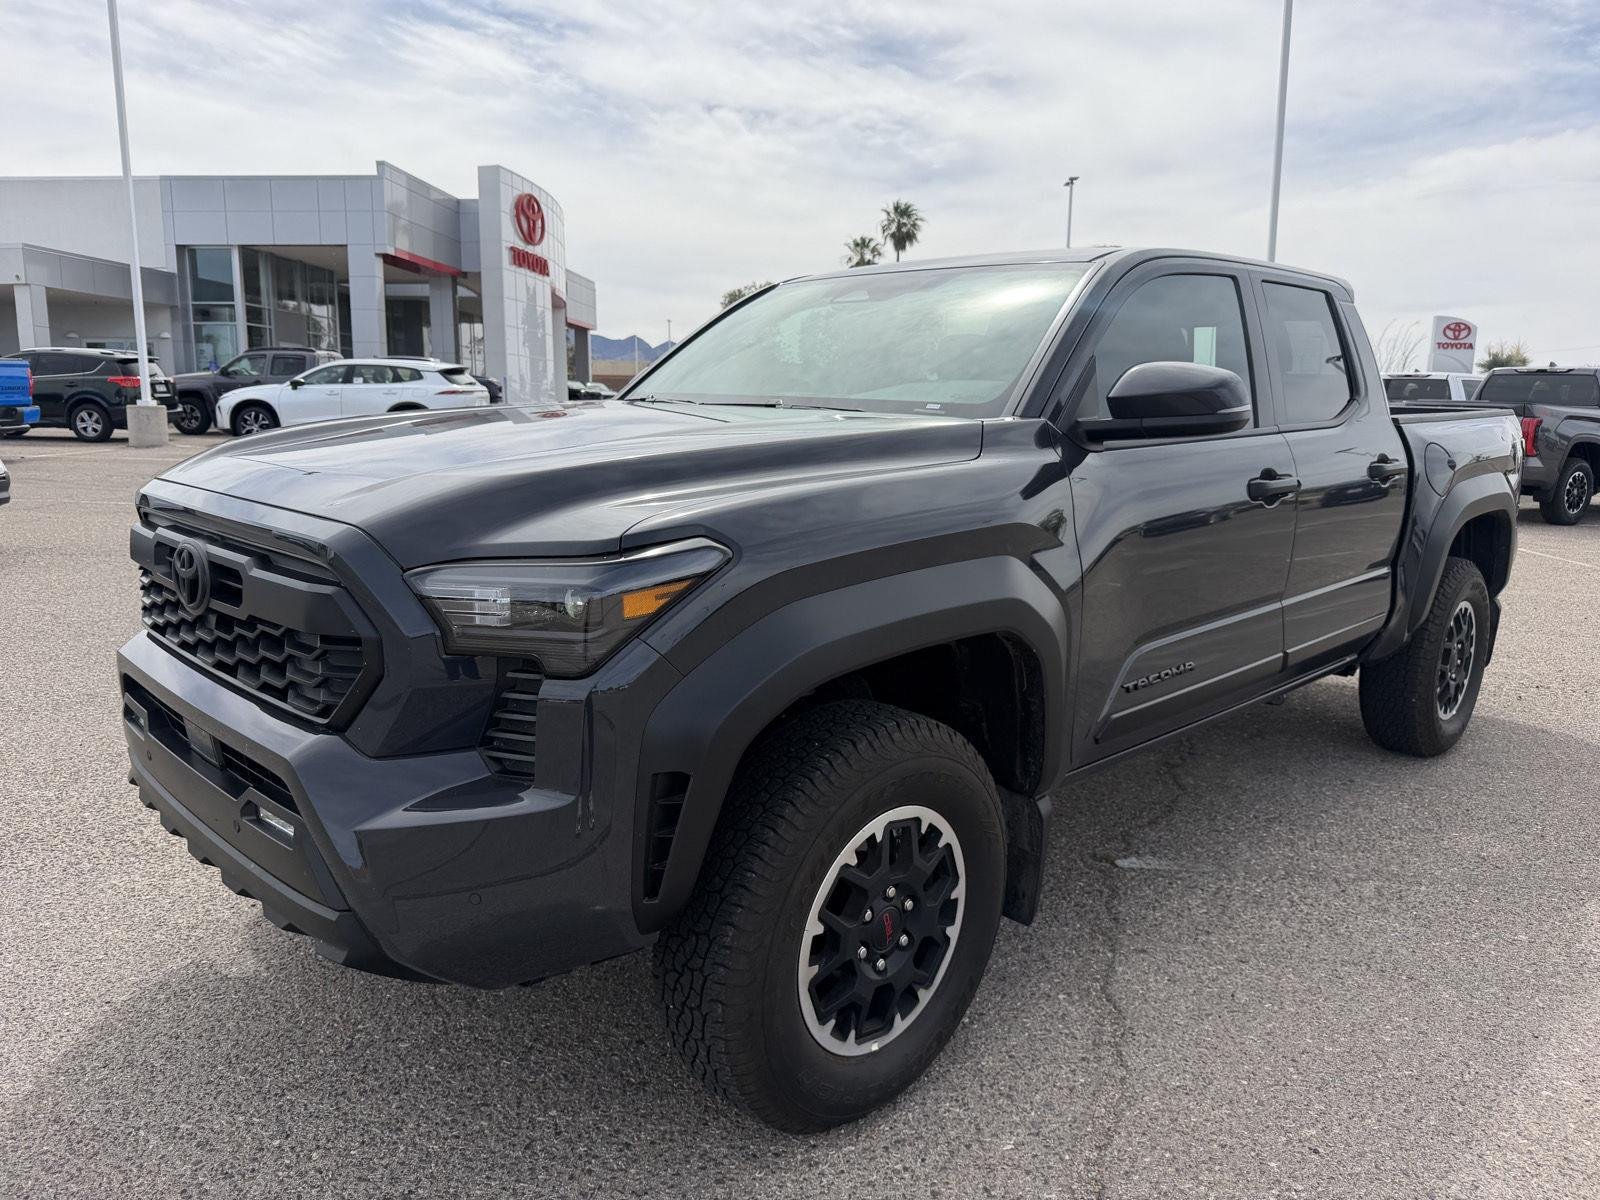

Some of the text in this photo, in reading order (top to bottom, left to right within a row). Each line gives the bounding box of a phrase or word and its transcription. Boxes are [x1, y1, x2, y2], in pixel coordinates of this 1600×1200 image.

[510, 246, 550, 277] TOYOTA
[1436, 342, 1474, 351] TOYOTA
[1121, 661, 1196, 693] TACOMA
